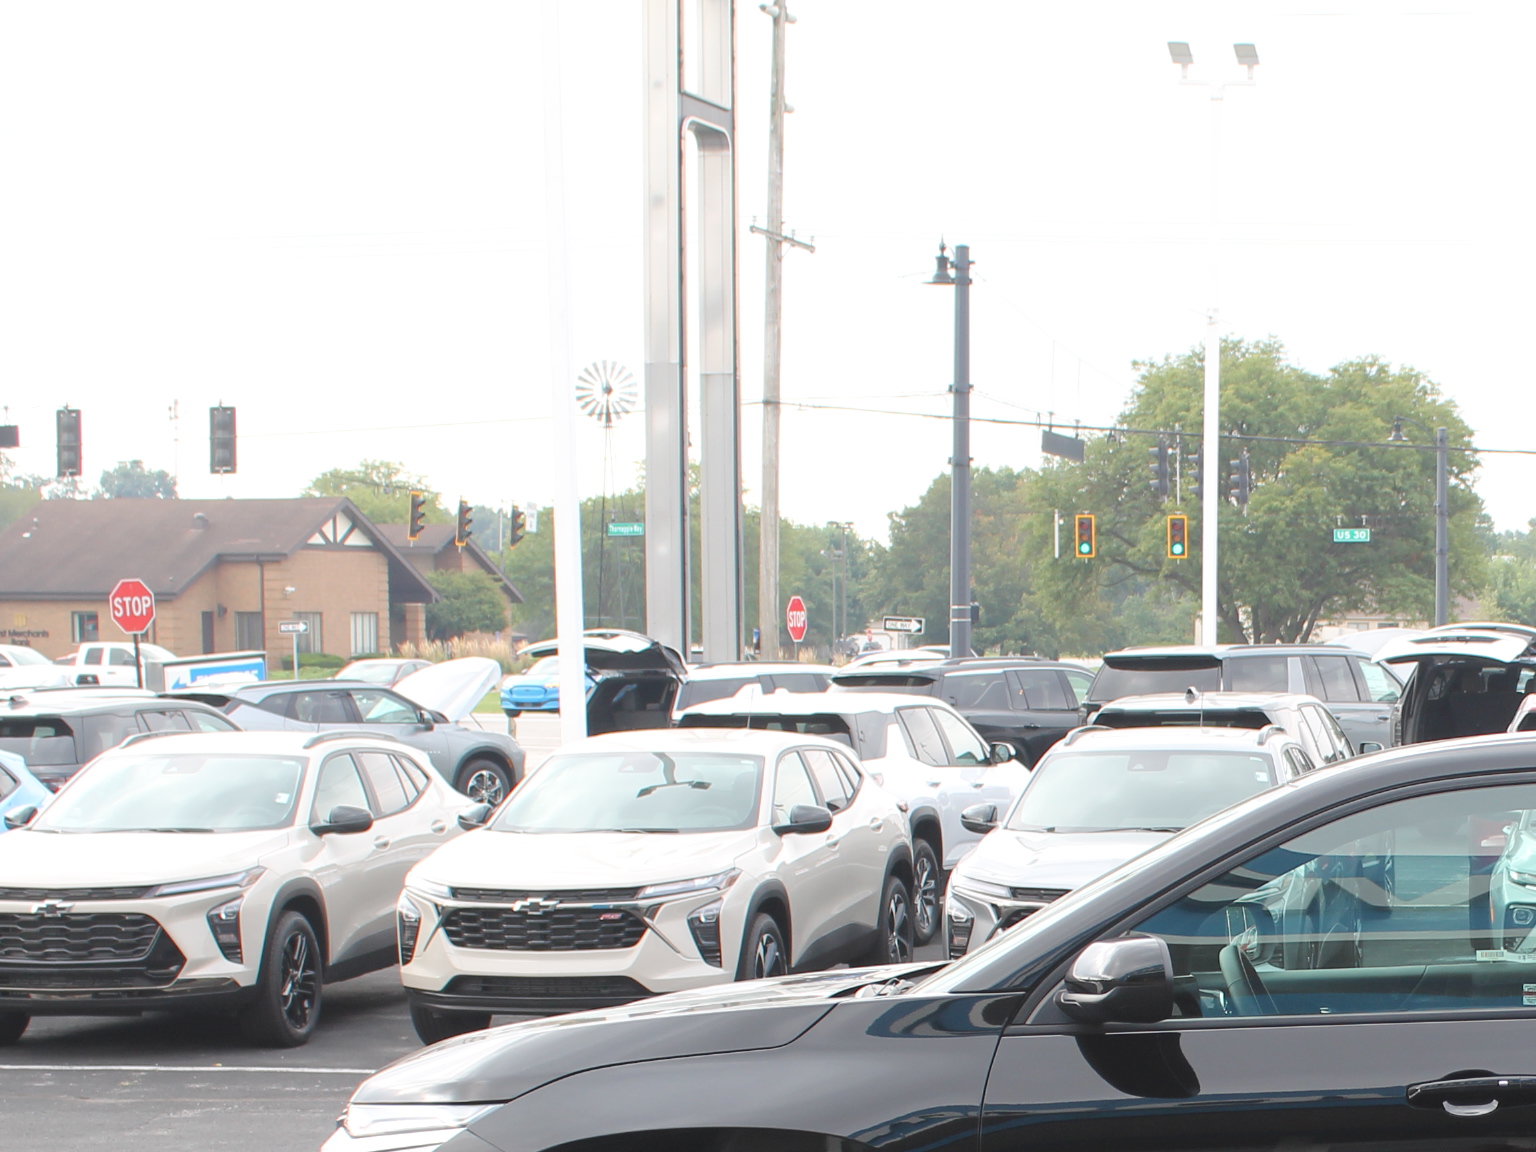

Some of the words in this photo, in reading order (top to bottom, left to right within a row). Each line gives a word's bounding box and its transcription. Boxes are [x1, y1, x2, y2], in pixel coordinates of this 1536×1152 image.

[1337, 531, 1351, 539] US
[1353, 531, 1366, 539] 30
[114, 596, 151, 617] STOP
[789, 611, 806, 628] STOP
